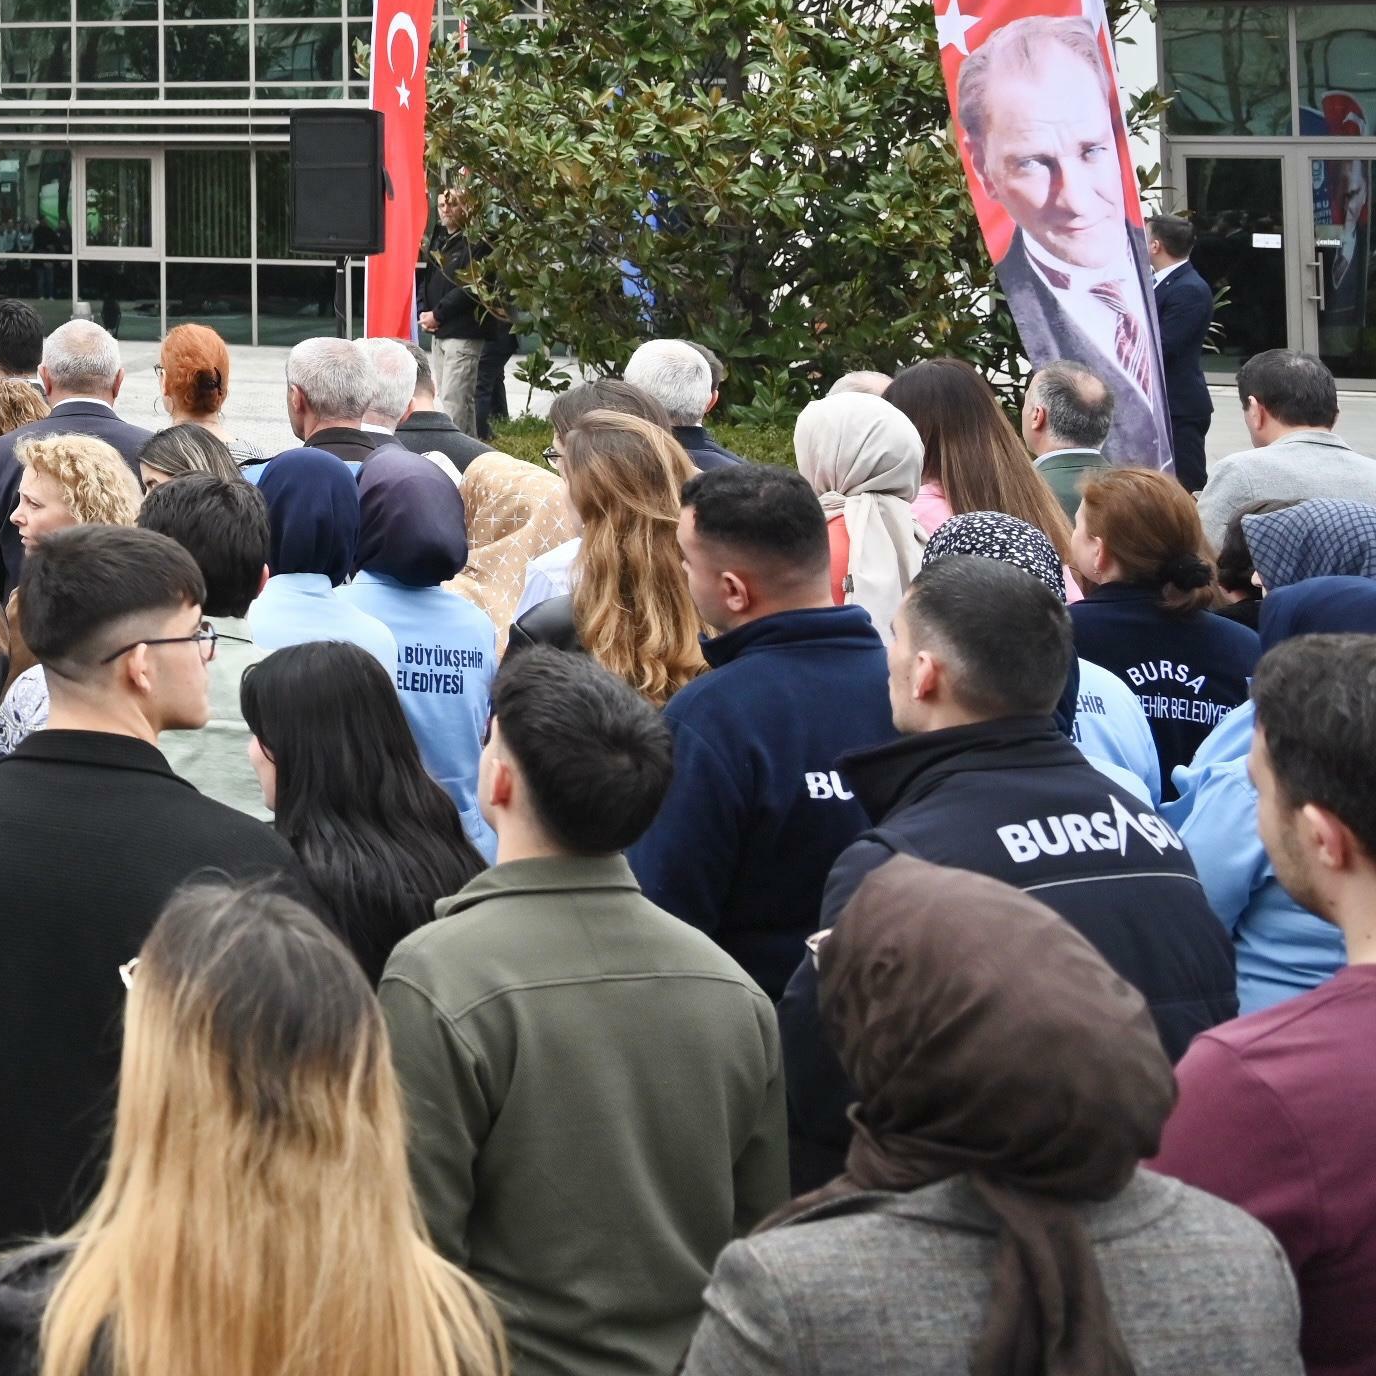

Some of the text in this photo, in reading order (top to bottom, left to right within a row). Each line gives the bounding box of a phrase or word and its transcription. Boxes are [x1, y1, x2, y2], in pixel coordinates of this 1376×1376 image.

[405, 643, 483, 672] BÜYÜKŞEHİR
[397, 669, 464, 695] ELEDİYESİ
[1126, 660, 1206, 694] BURSA
[996, 794, 1183, 863] BURSASU
